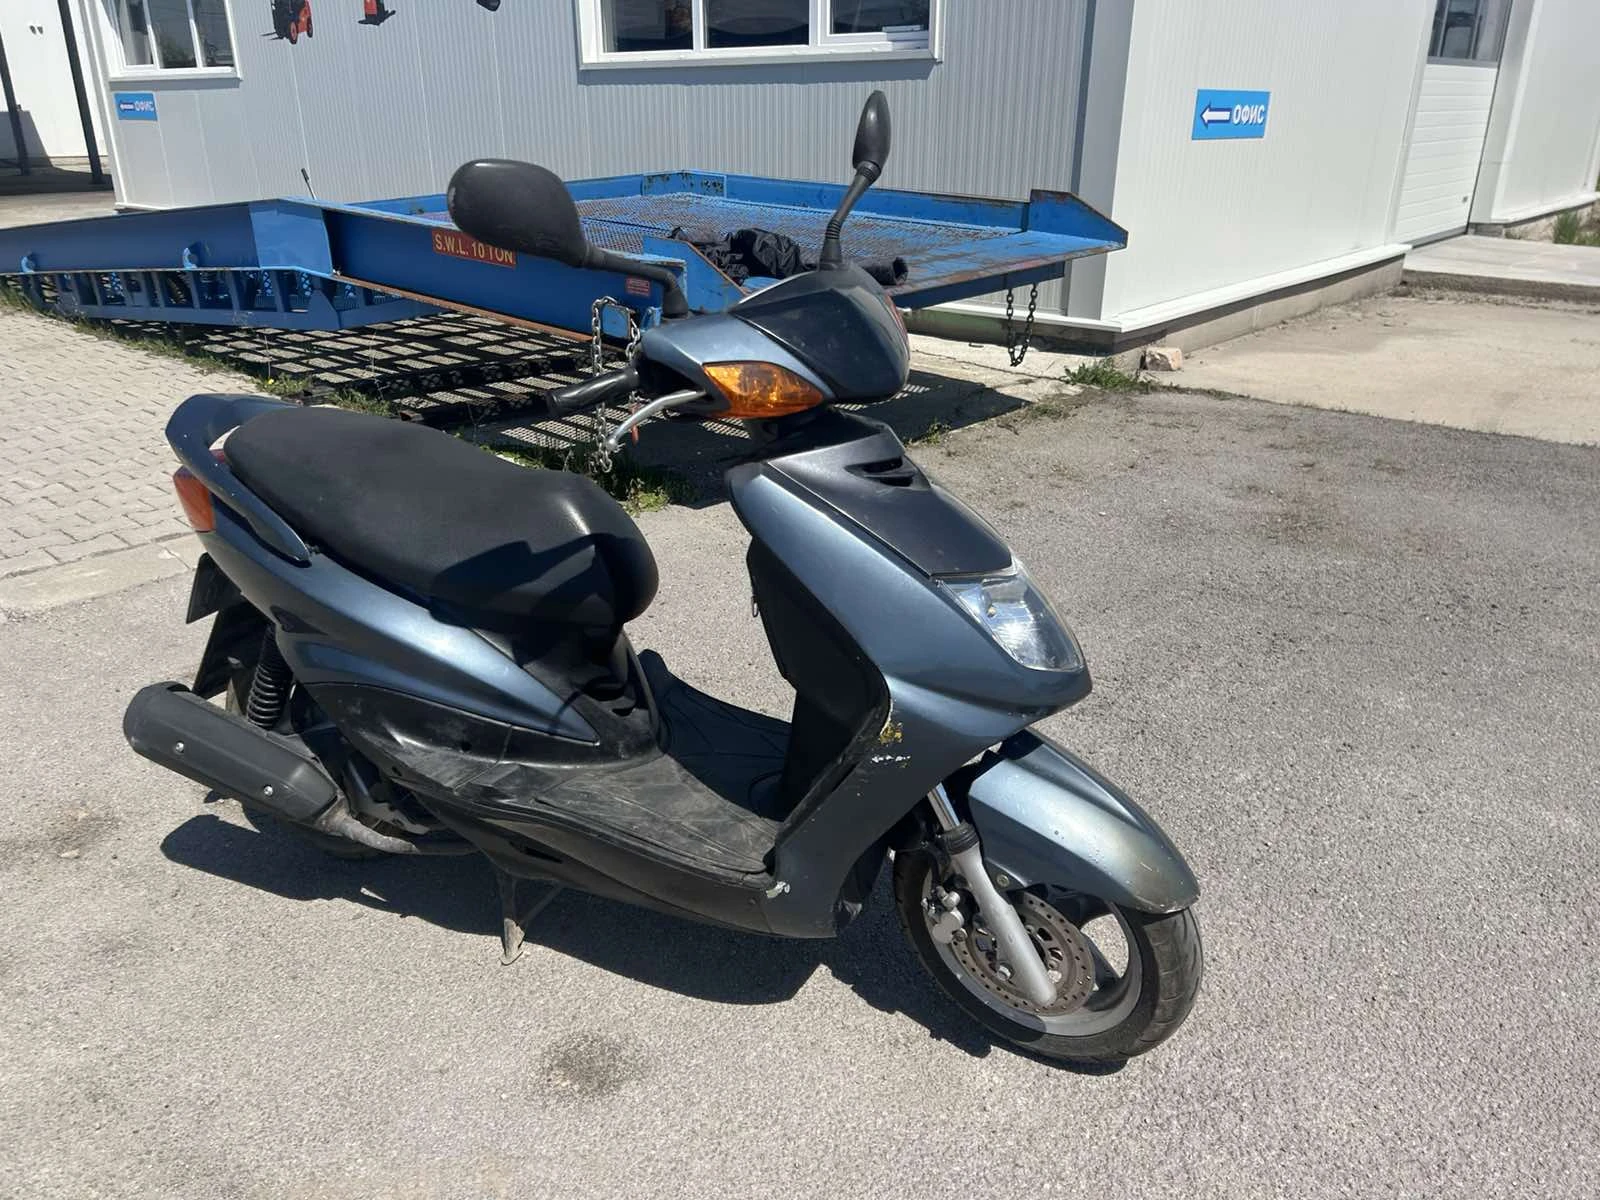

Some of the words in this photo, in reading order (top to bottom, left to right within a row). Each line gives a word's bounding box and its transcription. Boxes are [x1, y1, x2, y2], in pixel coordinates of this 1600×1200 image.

[1232, 104, 1265, 125] ОФИС
[434, 233, 468, 255] S.W.L.
[472, 241, 485, 258] 10
